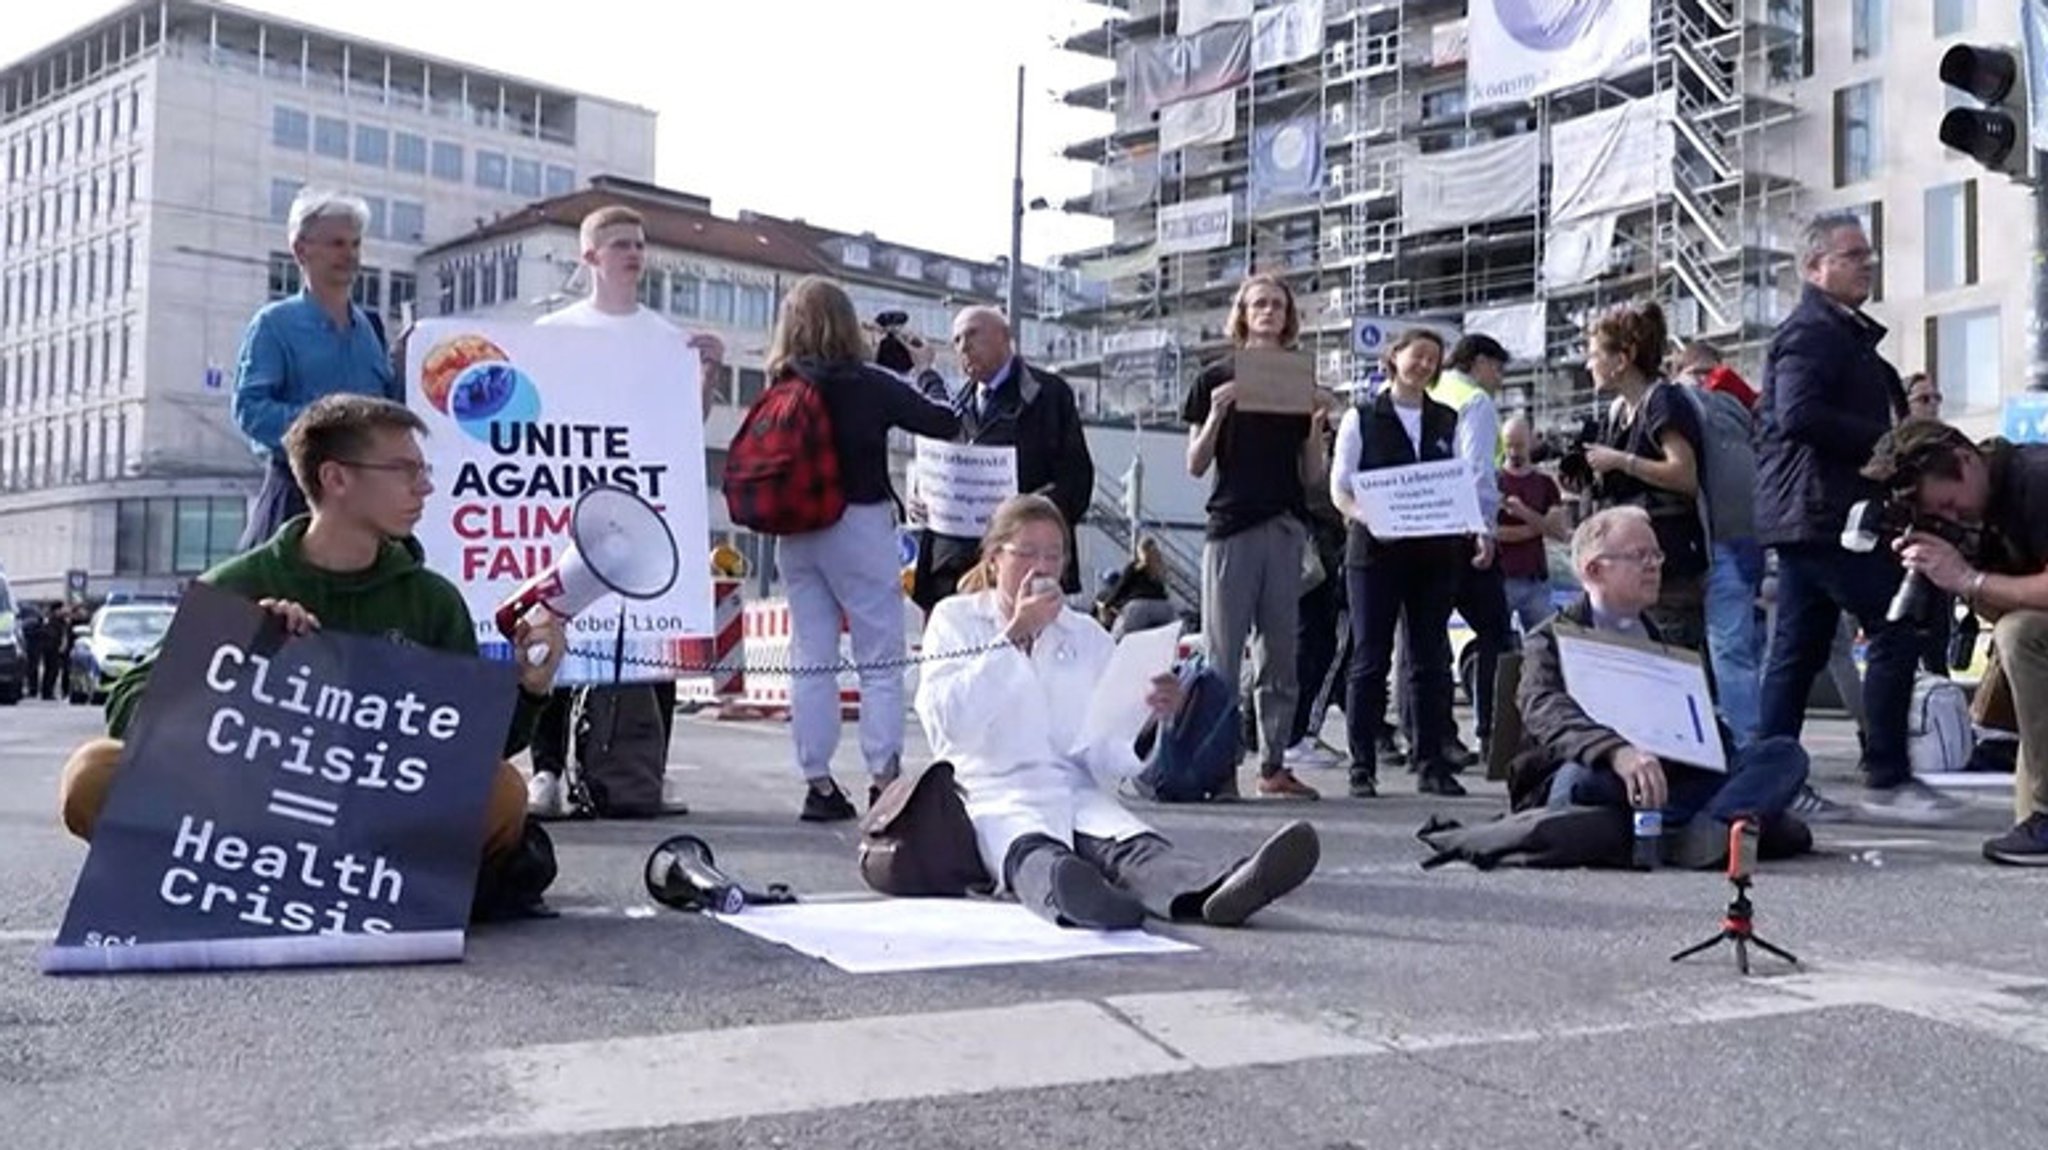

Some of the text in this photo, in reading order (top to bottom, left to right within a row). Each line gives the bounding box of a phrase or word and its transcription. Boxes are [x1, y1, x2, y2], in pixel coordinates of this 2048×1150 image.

[452, 463, 667, 498] AGAINST
[489, 421, 630, 459] UNITE
[206, 644, 462, 741] Climate
[206, 707, 429, 795] Crisis
[172, 814, 404, 905] Health
